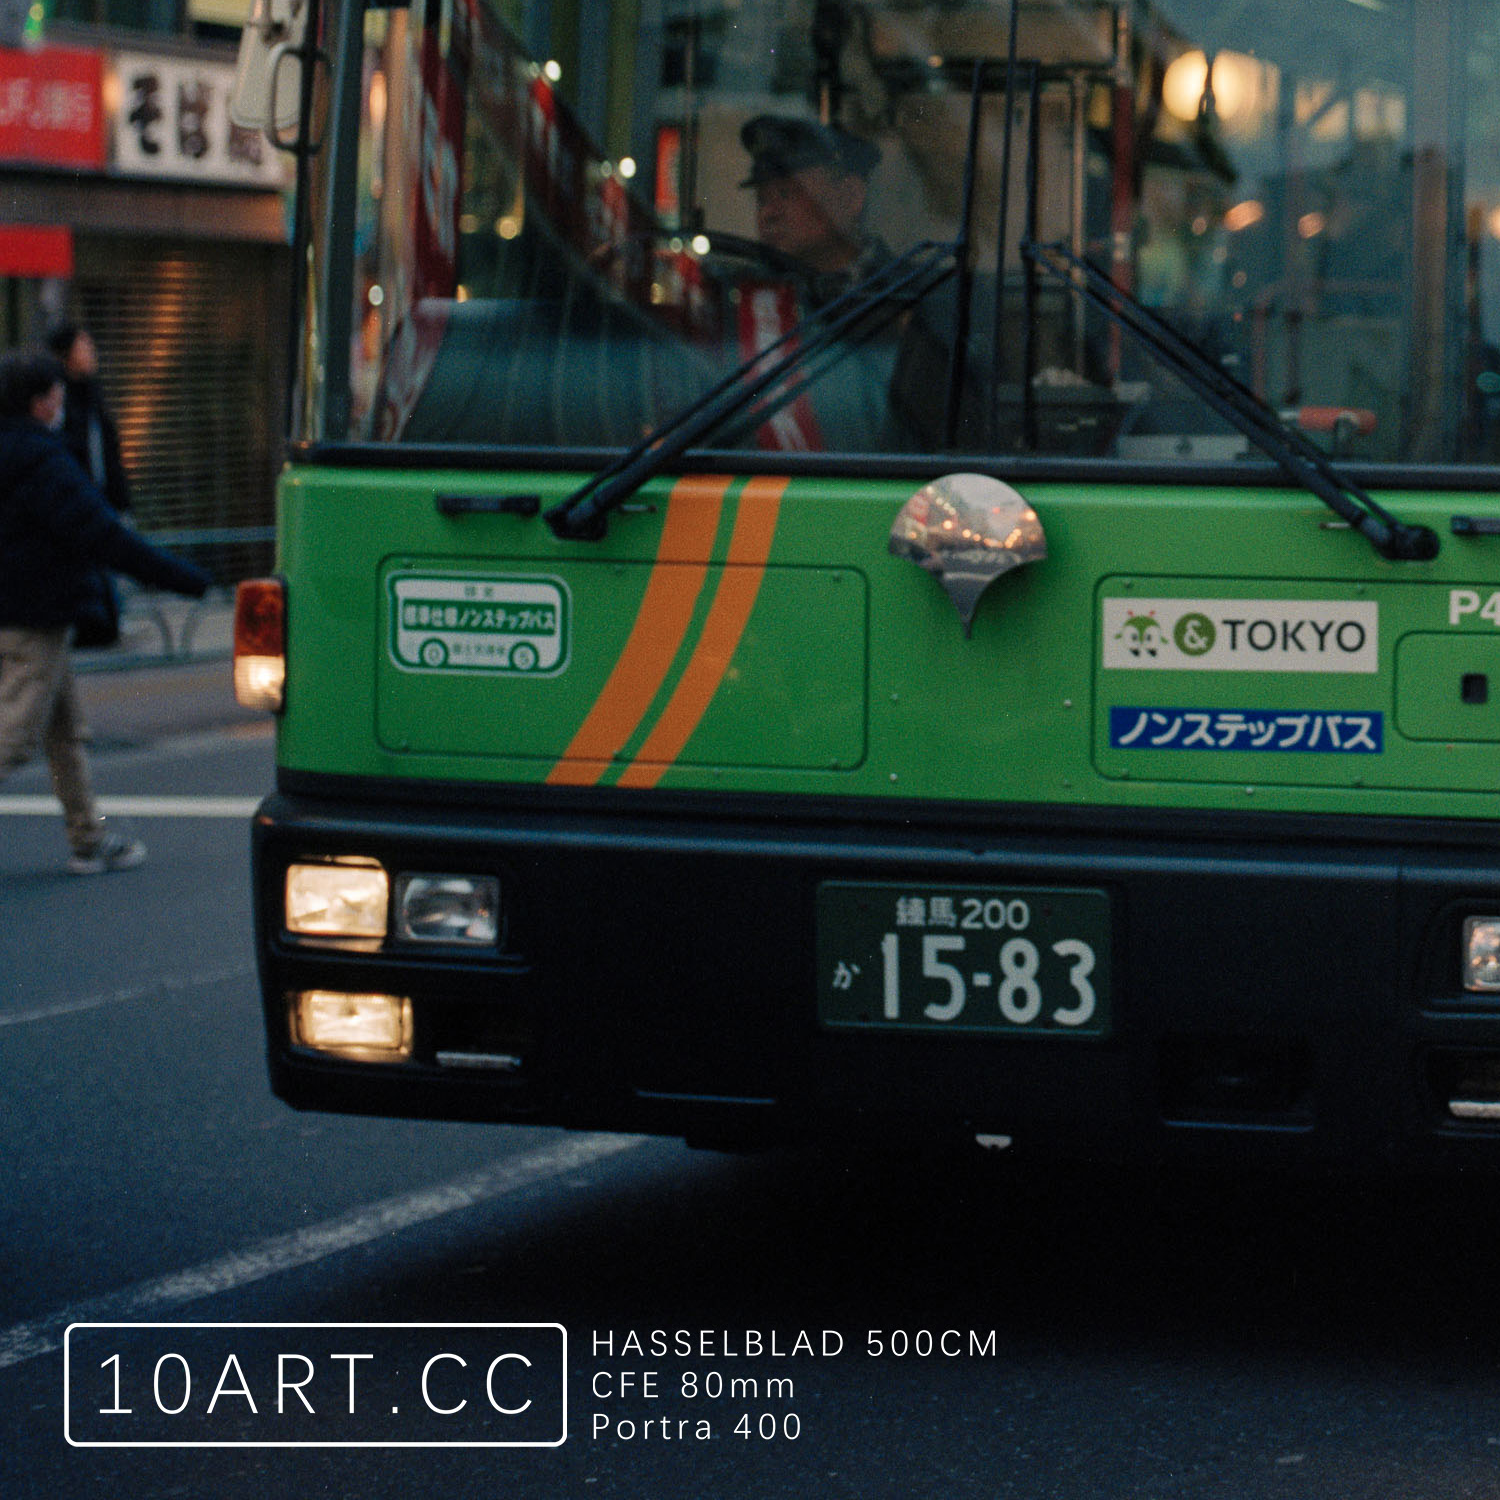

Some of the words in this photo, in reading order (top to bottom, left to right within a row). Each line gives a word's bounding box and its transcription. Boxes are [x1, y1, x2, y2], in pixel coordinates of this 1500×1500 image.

[1222, 618, 1367, 654] TOKYO
[1118, 712, 1376, 750] ノンステップバス
[881, 933, 1096, 1026] 15-83
